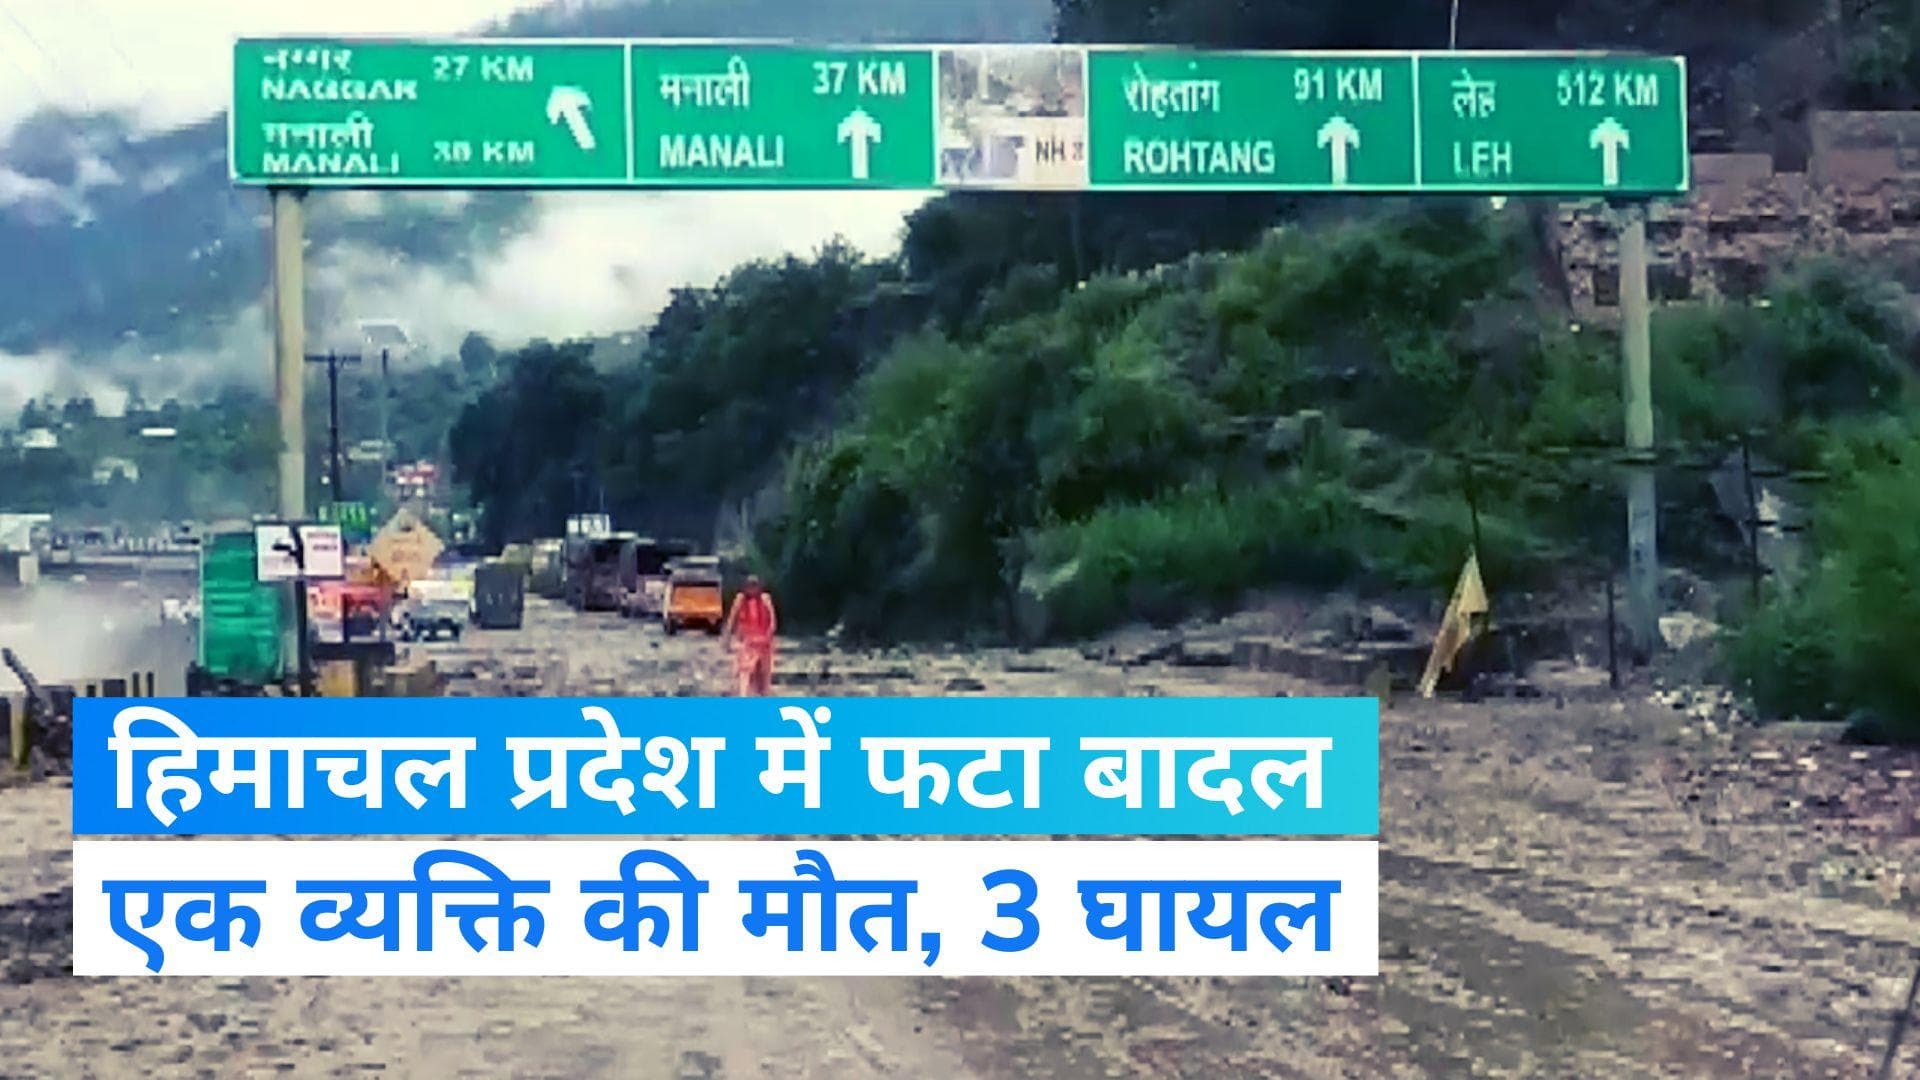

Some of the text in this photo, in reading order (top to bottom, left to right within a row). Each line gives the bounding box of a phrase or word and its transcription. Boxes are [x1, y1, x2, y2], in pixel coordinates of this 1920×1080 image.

[434, 55, 534, 81] 27 KM
[659, 56, 751, 108] मनाली
[812, 61, 907, 95] 37 KM
[1293, 67, 1383, 101] 91 KM
[1451, 68, 1496, 118] लेह
[1557, 70, 1659, 106] 512 KM
[263, 152, 400, 174] MANALI
[482, 141, 534, 162] KM
[659, 134, 785, 168] MANALI
[1035, 138, 1065, 162] NH
[1123, 139, 1275, 174] ROHTANG
